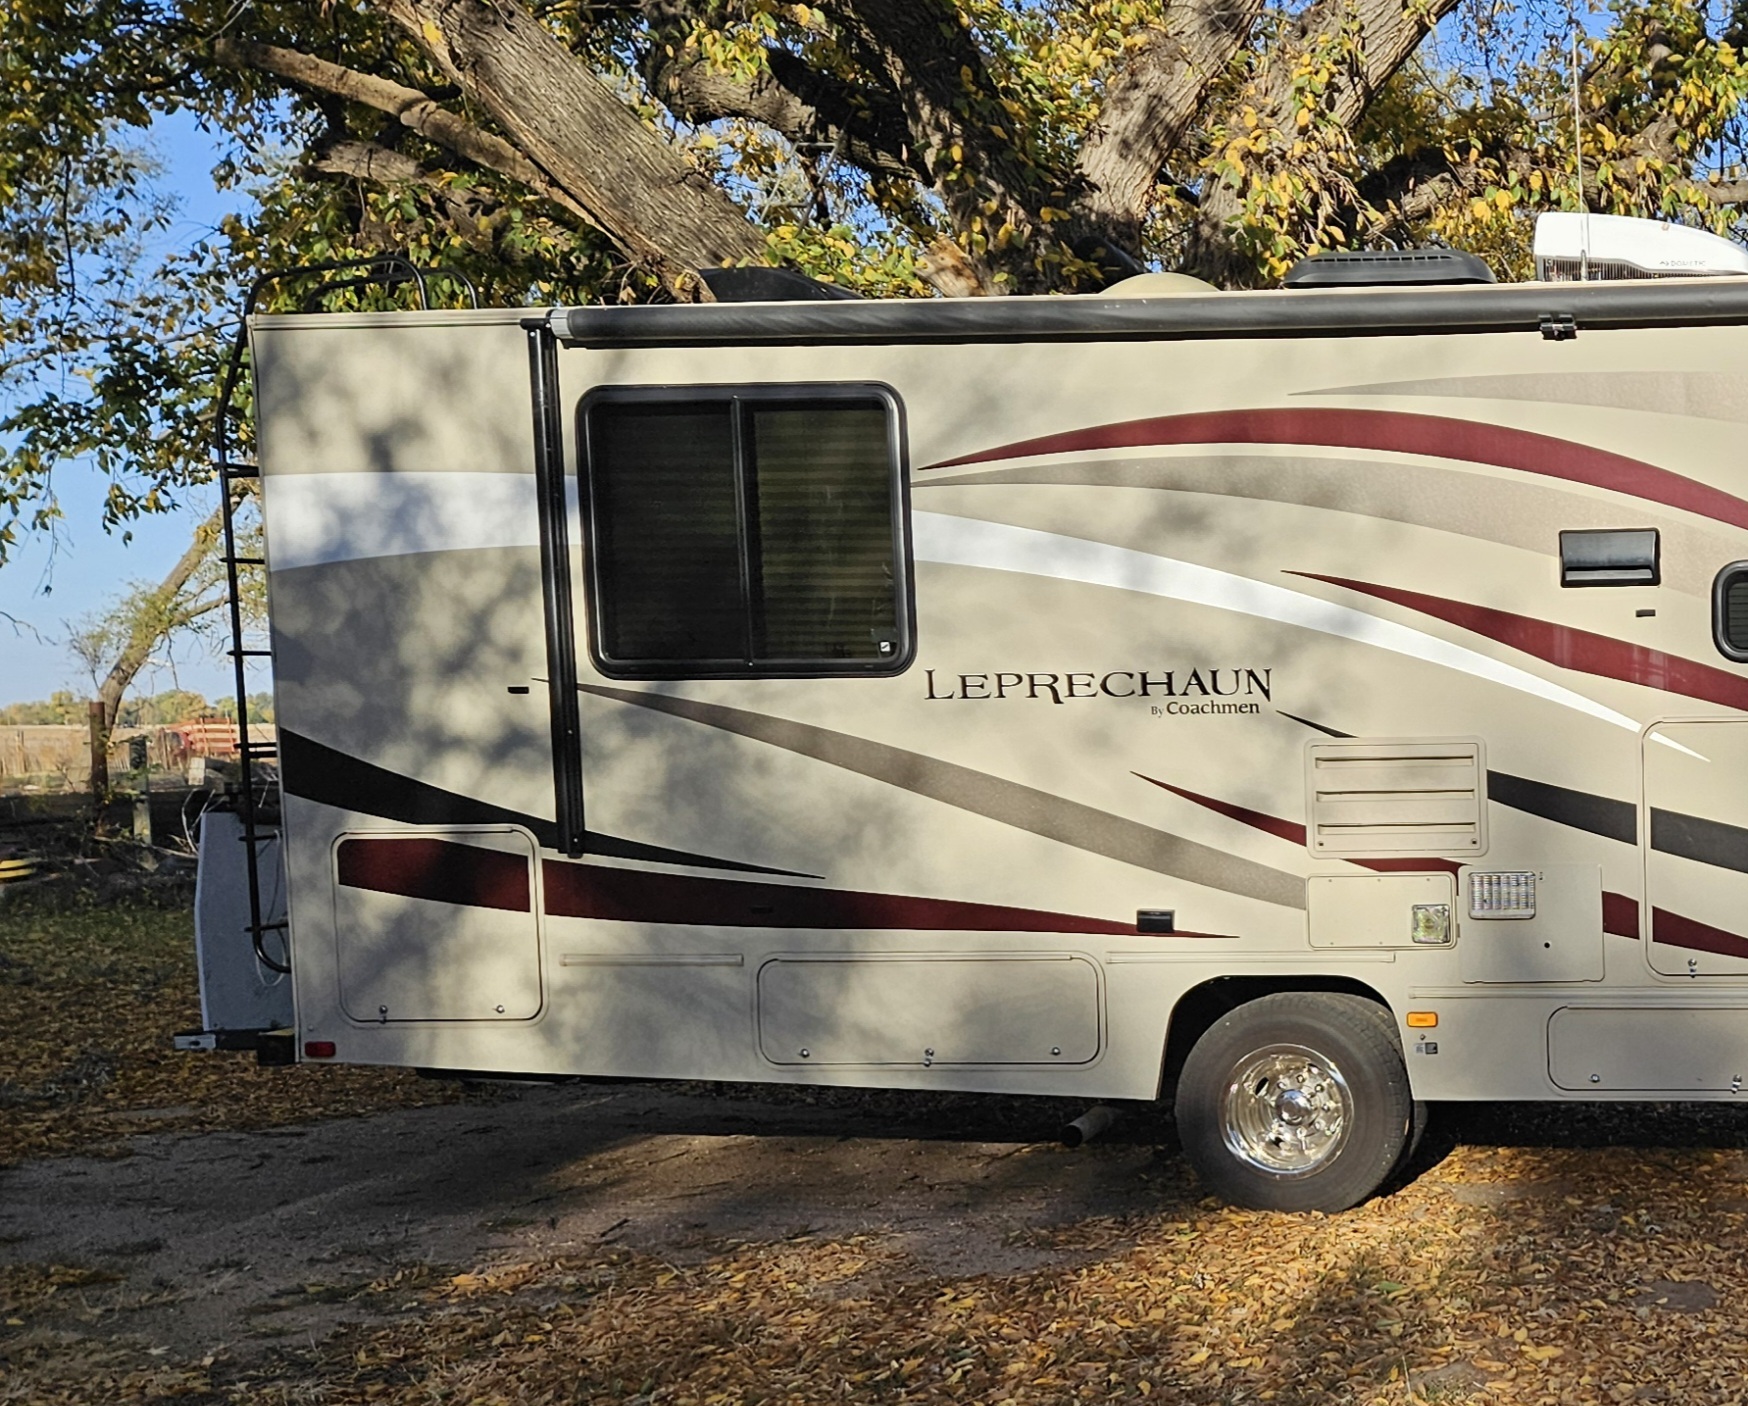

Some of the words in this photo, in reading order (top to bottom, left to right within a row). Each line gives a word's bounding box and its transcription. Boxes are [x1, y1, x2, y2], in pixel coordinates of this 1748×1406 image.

[924, 667, 1272, 704] LEPRECHAUN
[1151, 705, 1165, 718] By
[1166, 700, 1261, 716] Coachmen
